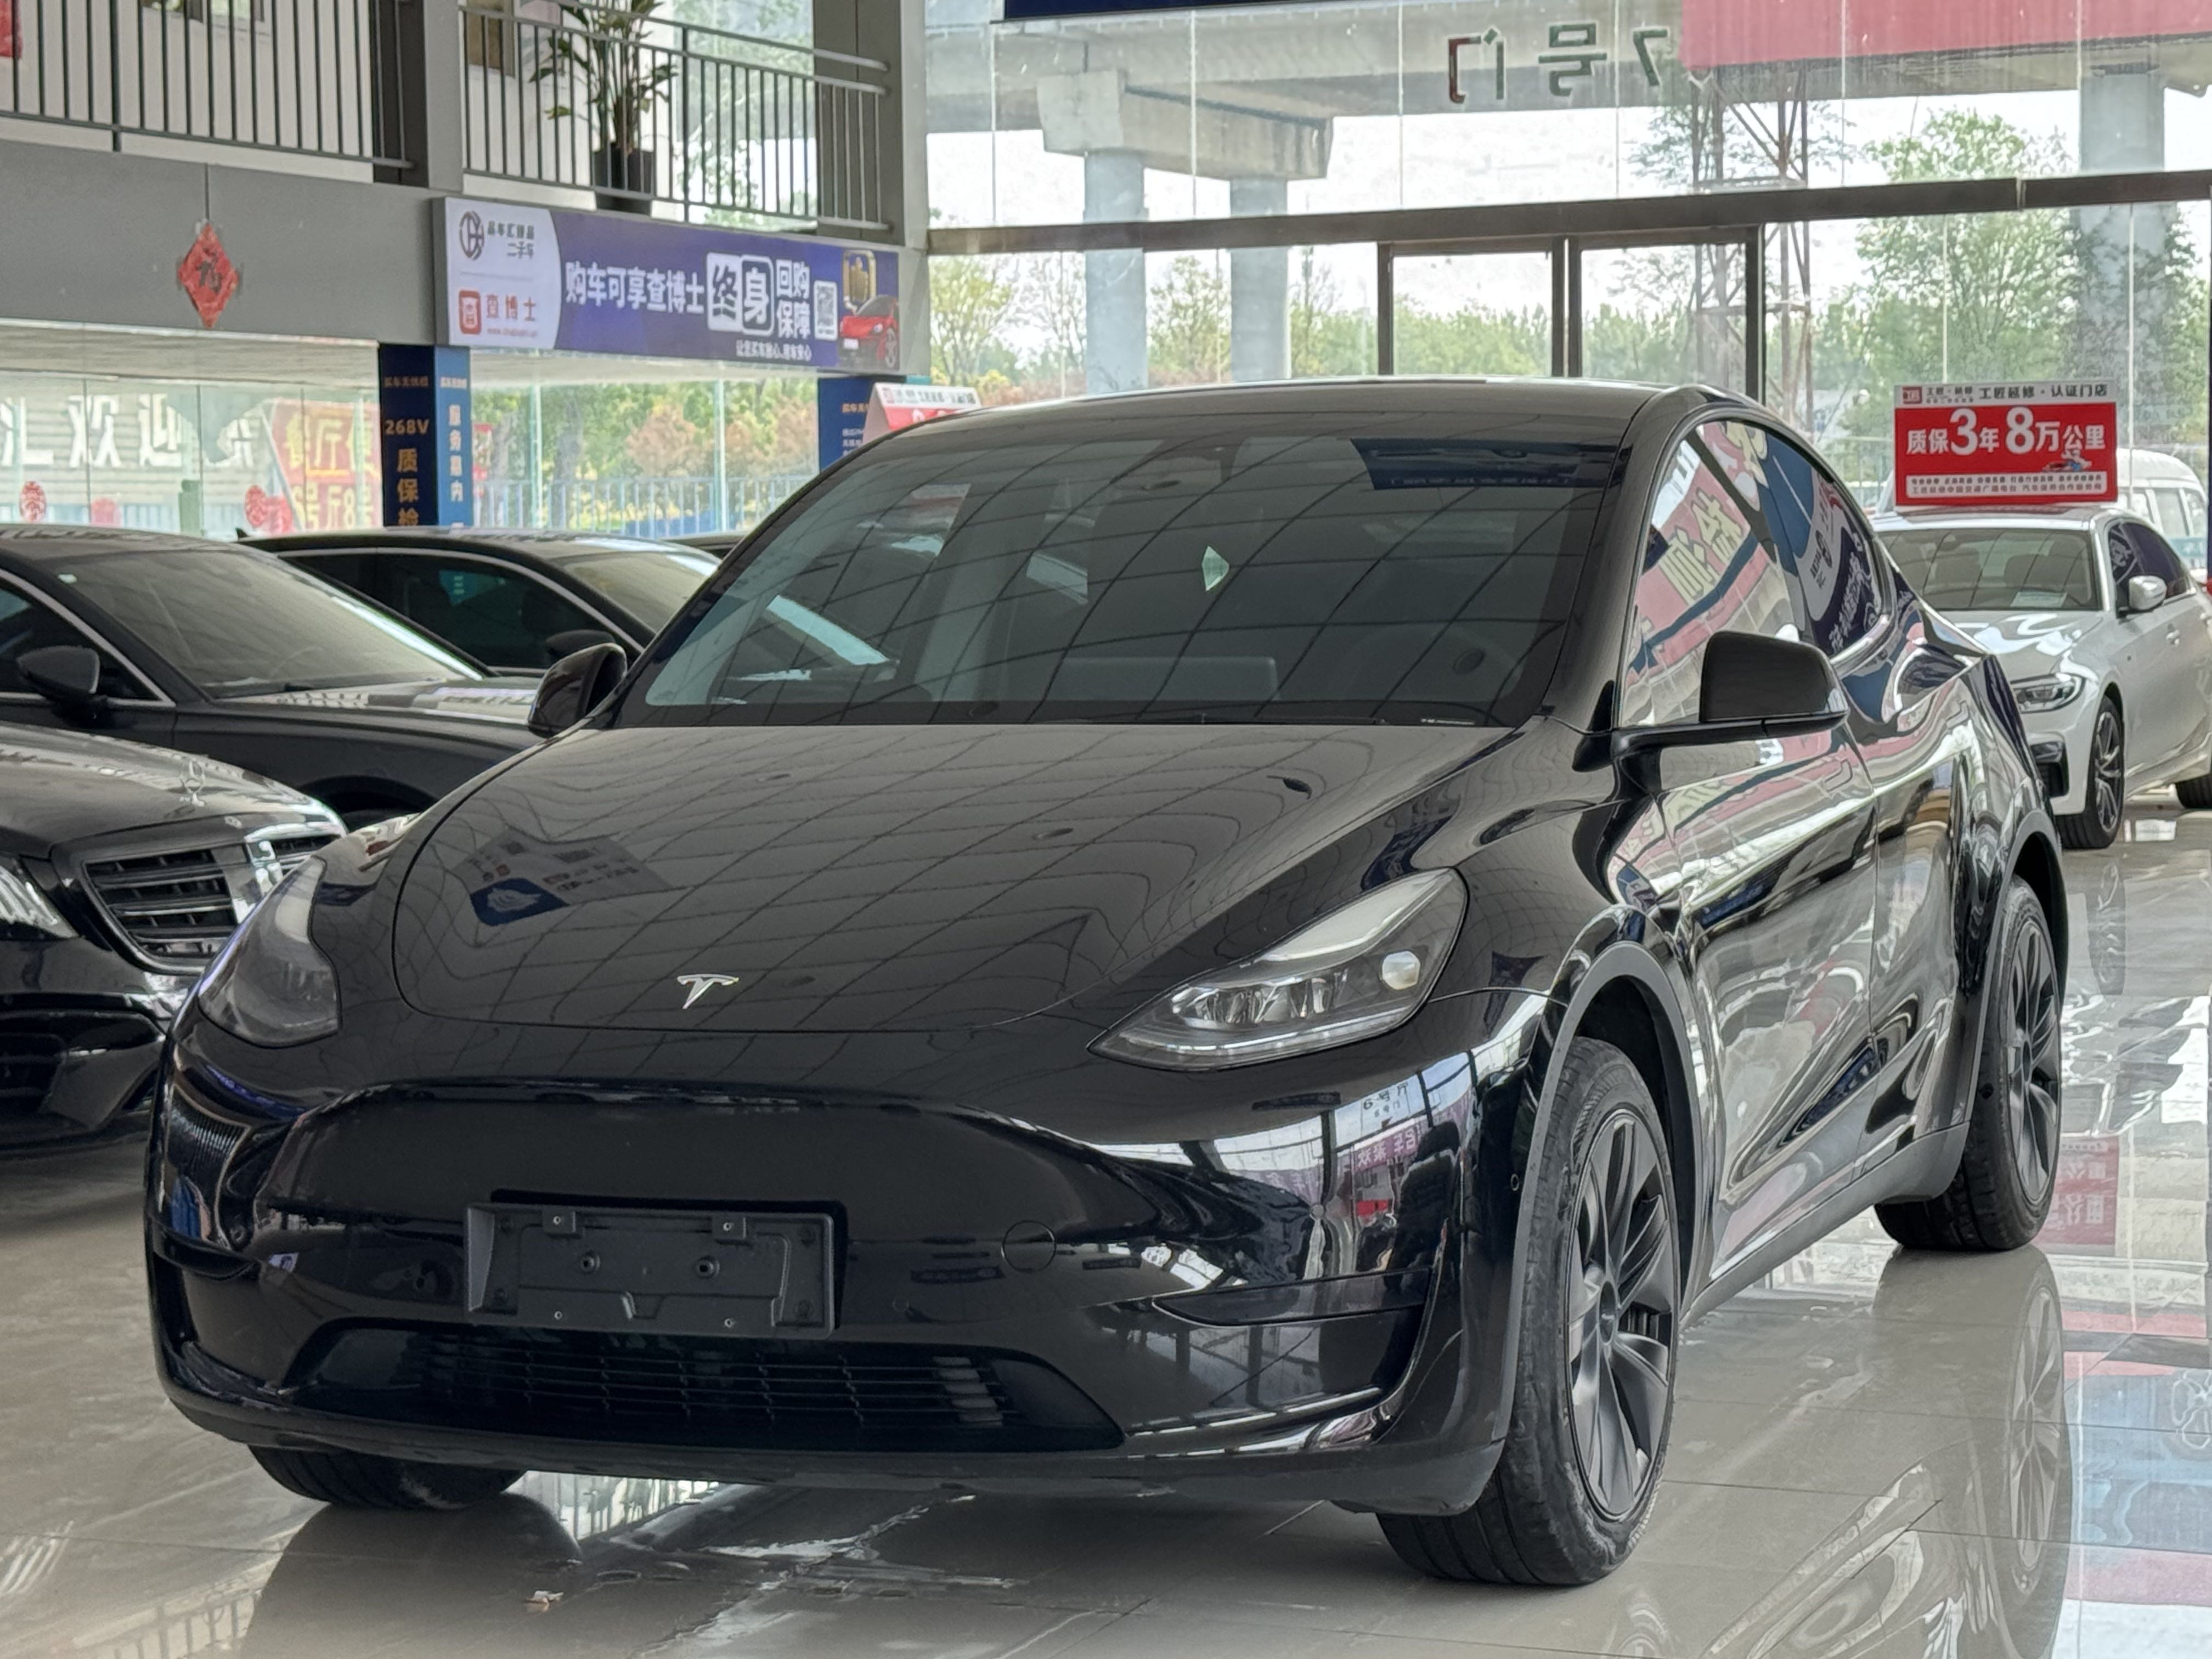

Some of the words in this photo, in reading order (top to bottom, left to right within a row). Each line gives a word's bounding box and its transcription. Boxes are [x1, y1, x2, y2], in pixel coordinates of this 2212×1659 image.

[566, 261, 705, 315] 购车可享查博士
[712, 263, 769, 325] 终身
[776, 259, 810, 300] 回购
[486, 294, 537, 322] 查博士
[776, 300, 811, 340] 保障
[385, 419, 430, 435] 268V
[1906, 407, 2106, 456] 质保3年8万公里
